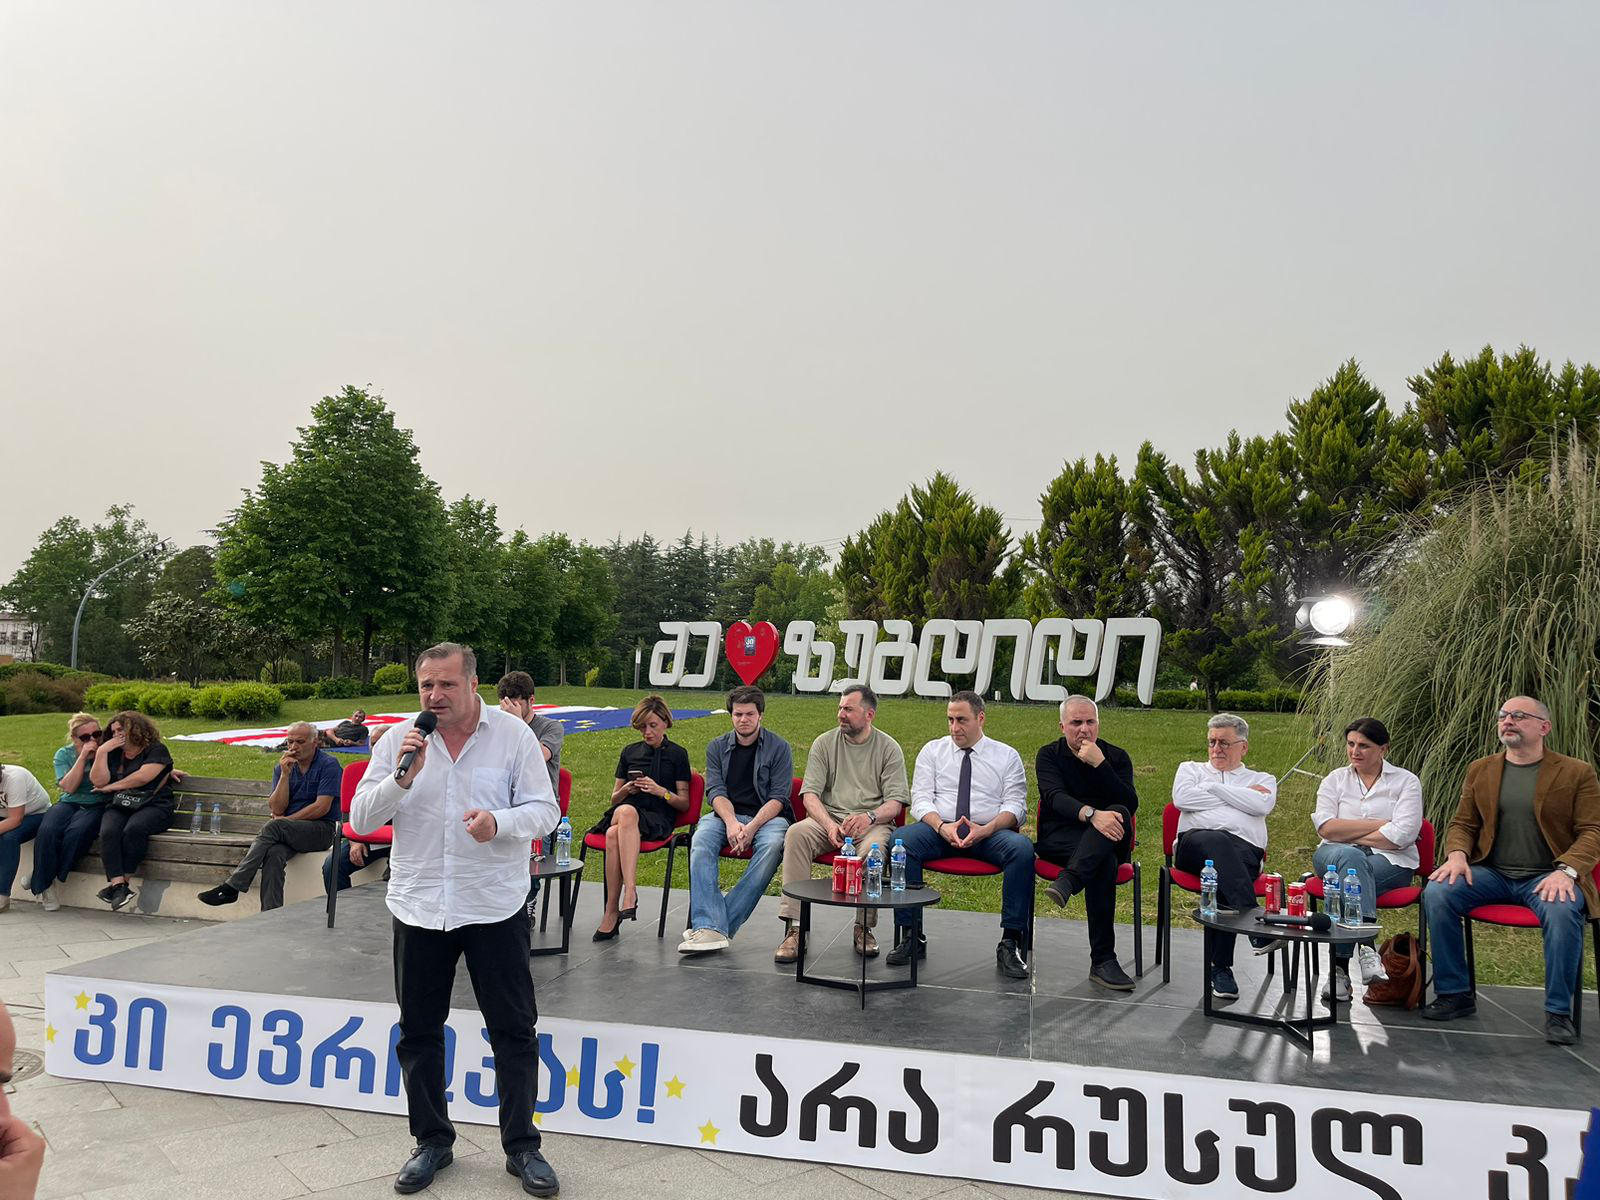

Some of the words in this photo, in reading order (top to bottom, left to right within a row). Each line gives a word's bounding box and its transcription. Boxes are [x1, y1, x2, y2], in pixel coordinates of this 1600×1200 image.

[648, 621, 722, 688] მე
[783, 617, 1162, 705] ზუგდიდი
[117, 793, 141, 803] GUCCI
[73, 993, 168, 1072] კი
[739, 1053, 940, 1155] არა
[992, 1080, 1424, 1200] რუსულ
